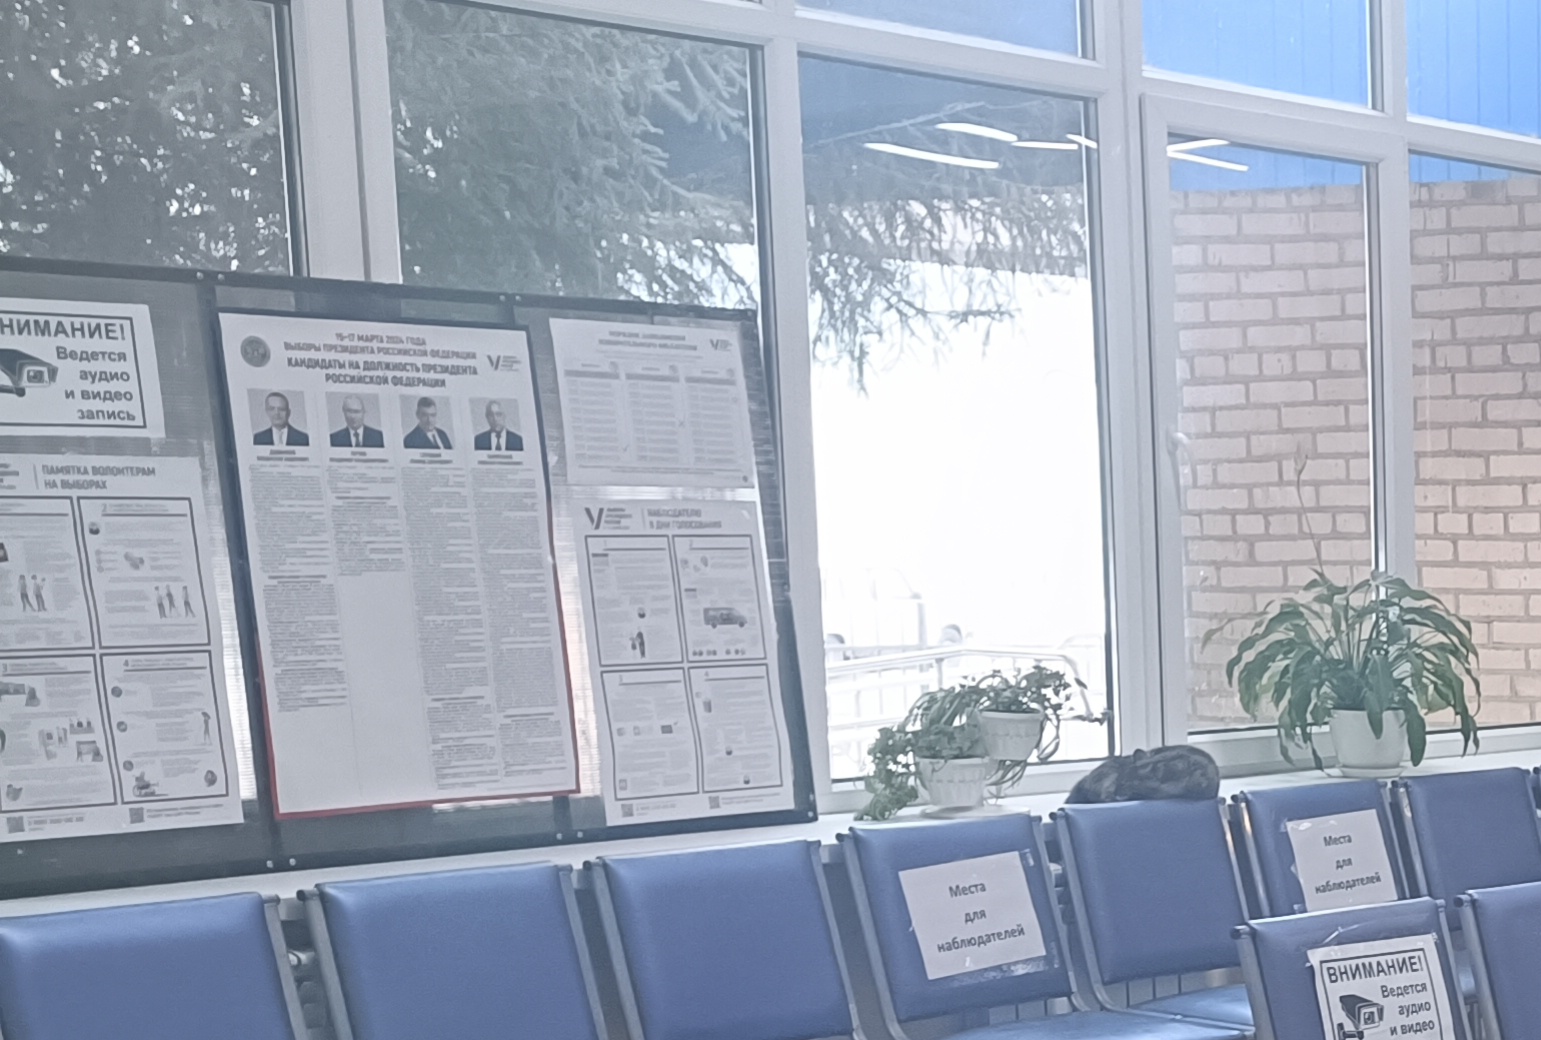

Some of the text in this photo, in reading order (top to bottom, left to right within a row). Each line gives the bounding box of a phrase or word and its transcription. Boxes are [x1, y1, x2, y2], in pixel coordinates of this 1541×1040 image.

[0, 317, 126, 341] НИМАНИЕ!
[55, 345, 127, 363] Ведется
[287, 356, 346, 369] КАНДИДАТЫ
[348, 360, 360, 370] НА
[363, 360, 420, 373] ДОЛЖНОСТЬ
[421, 363, 478, 376] ПРЕЗИДЕНТА
[79, 369, 131, 384] аудио
[325, 371, 446, 388] РОССИЙСКОЙ ФЕДЕРАЦИИ
[65, 389, 134, 403] и видео
[77, 408, 136, 421] запись
[42, 464, 156, 477] ПАМЯТКА ВОЛОНТЕРАМ
[44, 479, 108, 490] НА ВЫБОРАХ
[1323, 835, 1352, 846] Места
[1336, 858, 1352, 870] для
[948, 883, 987, 898] Места
[1315, 872, 1381, 894] наблюдателей
[965, 909, 987, 924] для
[937, 924, 1025, 953] наблюдателей
[1326, 955, 1424, 983] ВНИМАНИЕ!
[1380, 982, 1428, 998] Ведется
[1398, 1001, 1431, 1018] аудио
[1389, 1020, 1435, 1036] и видео
